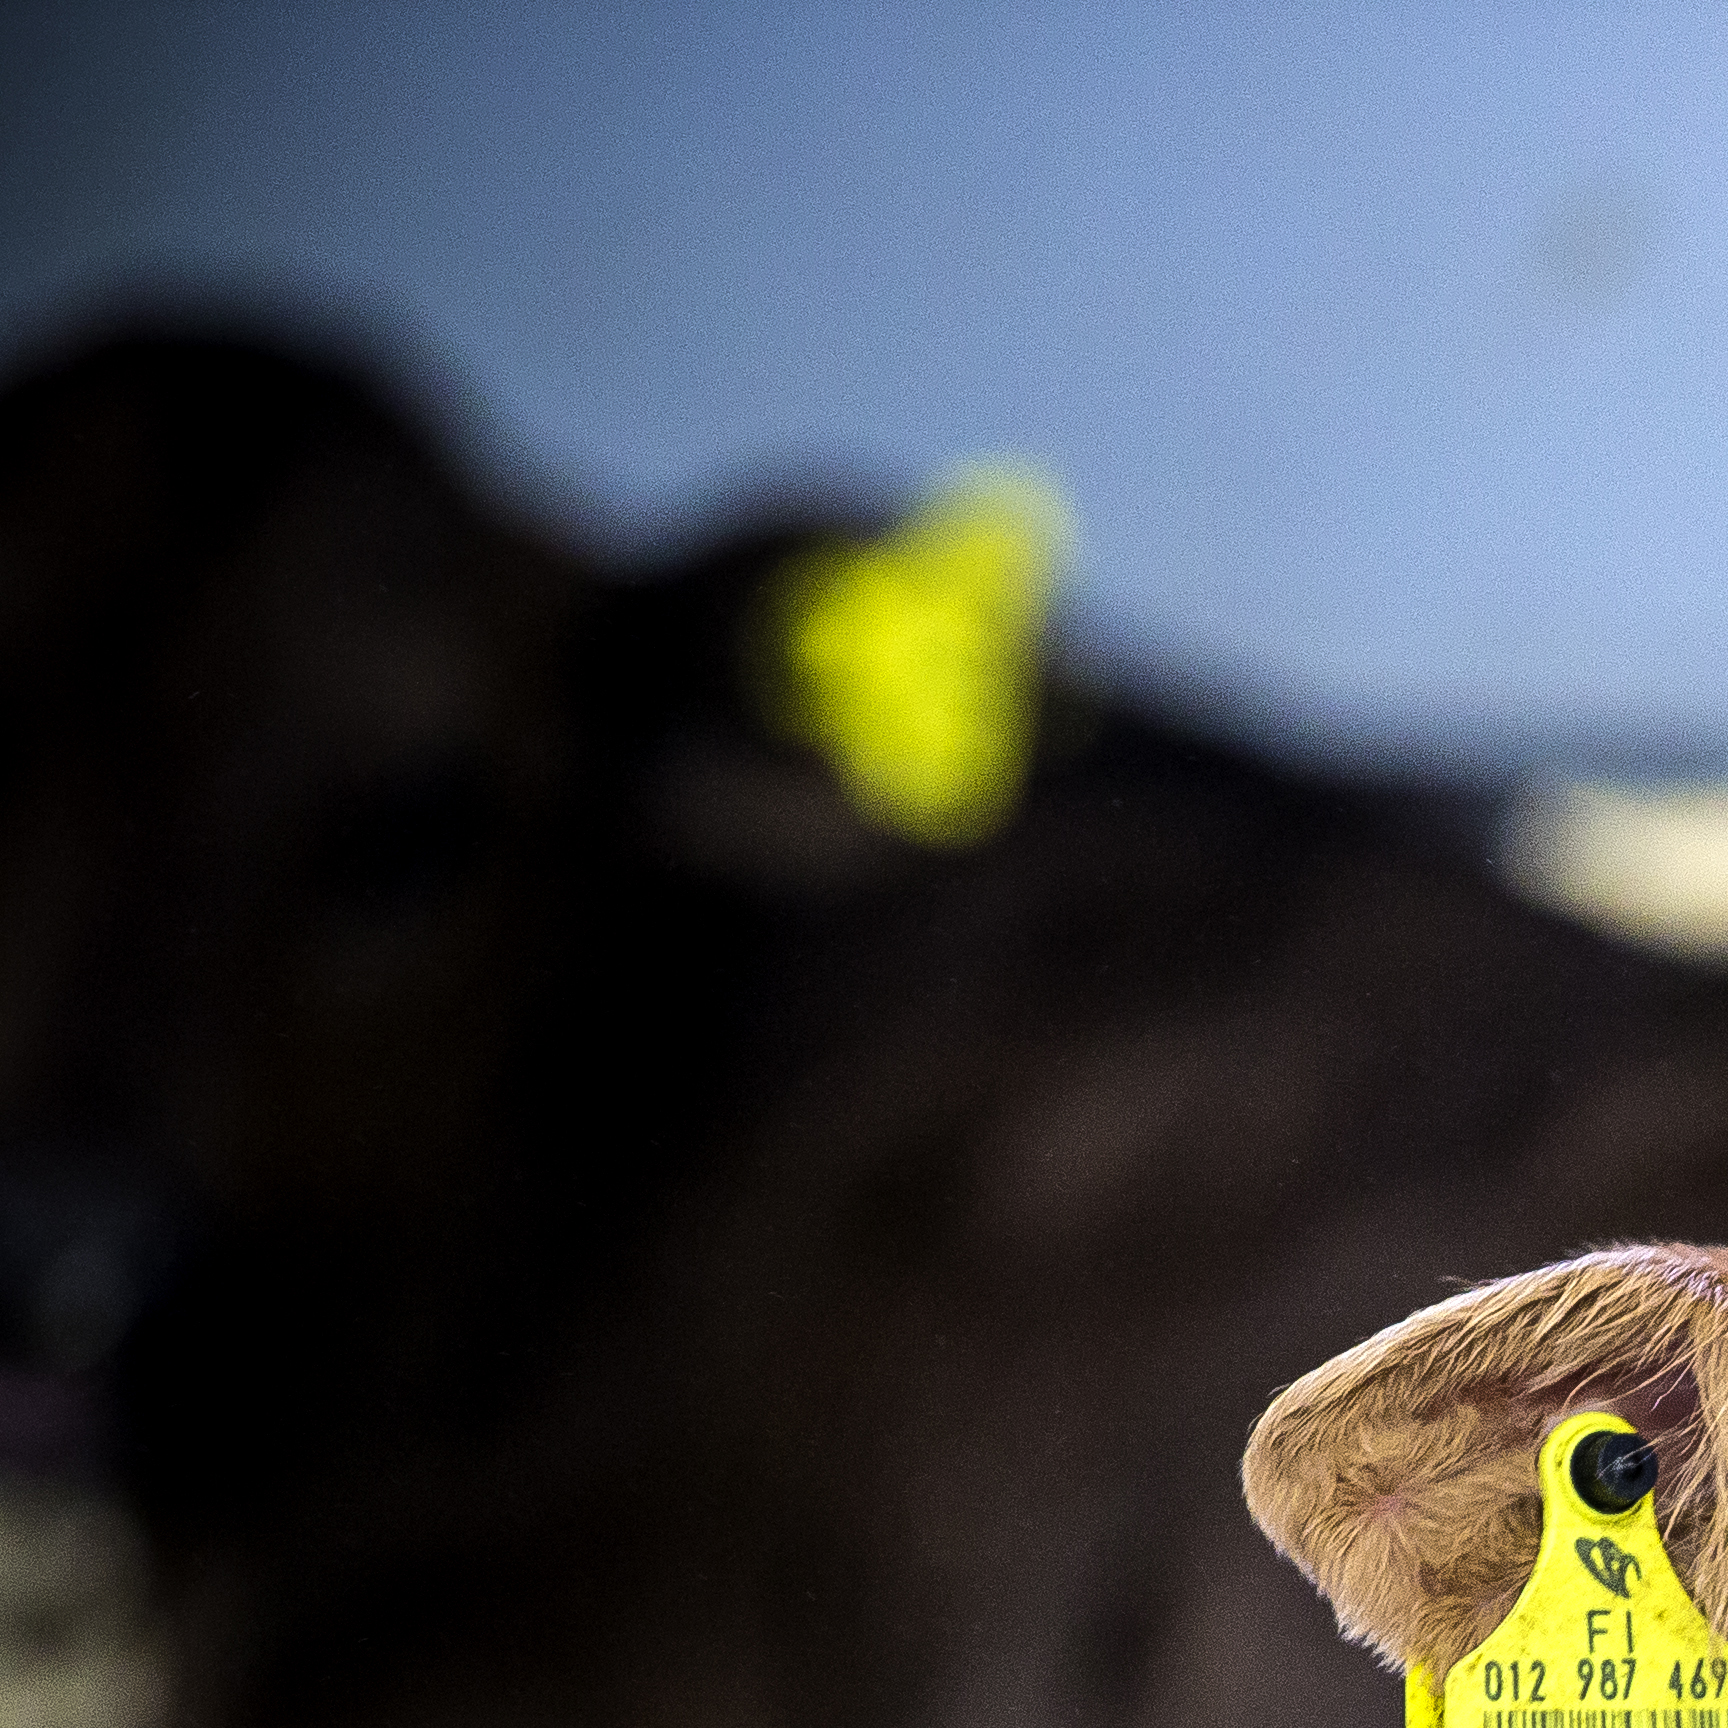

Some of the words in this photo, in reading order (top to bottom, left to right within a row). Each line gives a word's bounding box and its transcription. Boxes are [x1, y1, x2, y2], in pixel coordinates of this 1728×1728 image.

[1586, 1609, 1633, 1654] FI
[1484, 1659, 1546, 1702] 012
[1578, 1658, 1637, 1701] 987
[1669, 1658, 1728, 1700] 469
